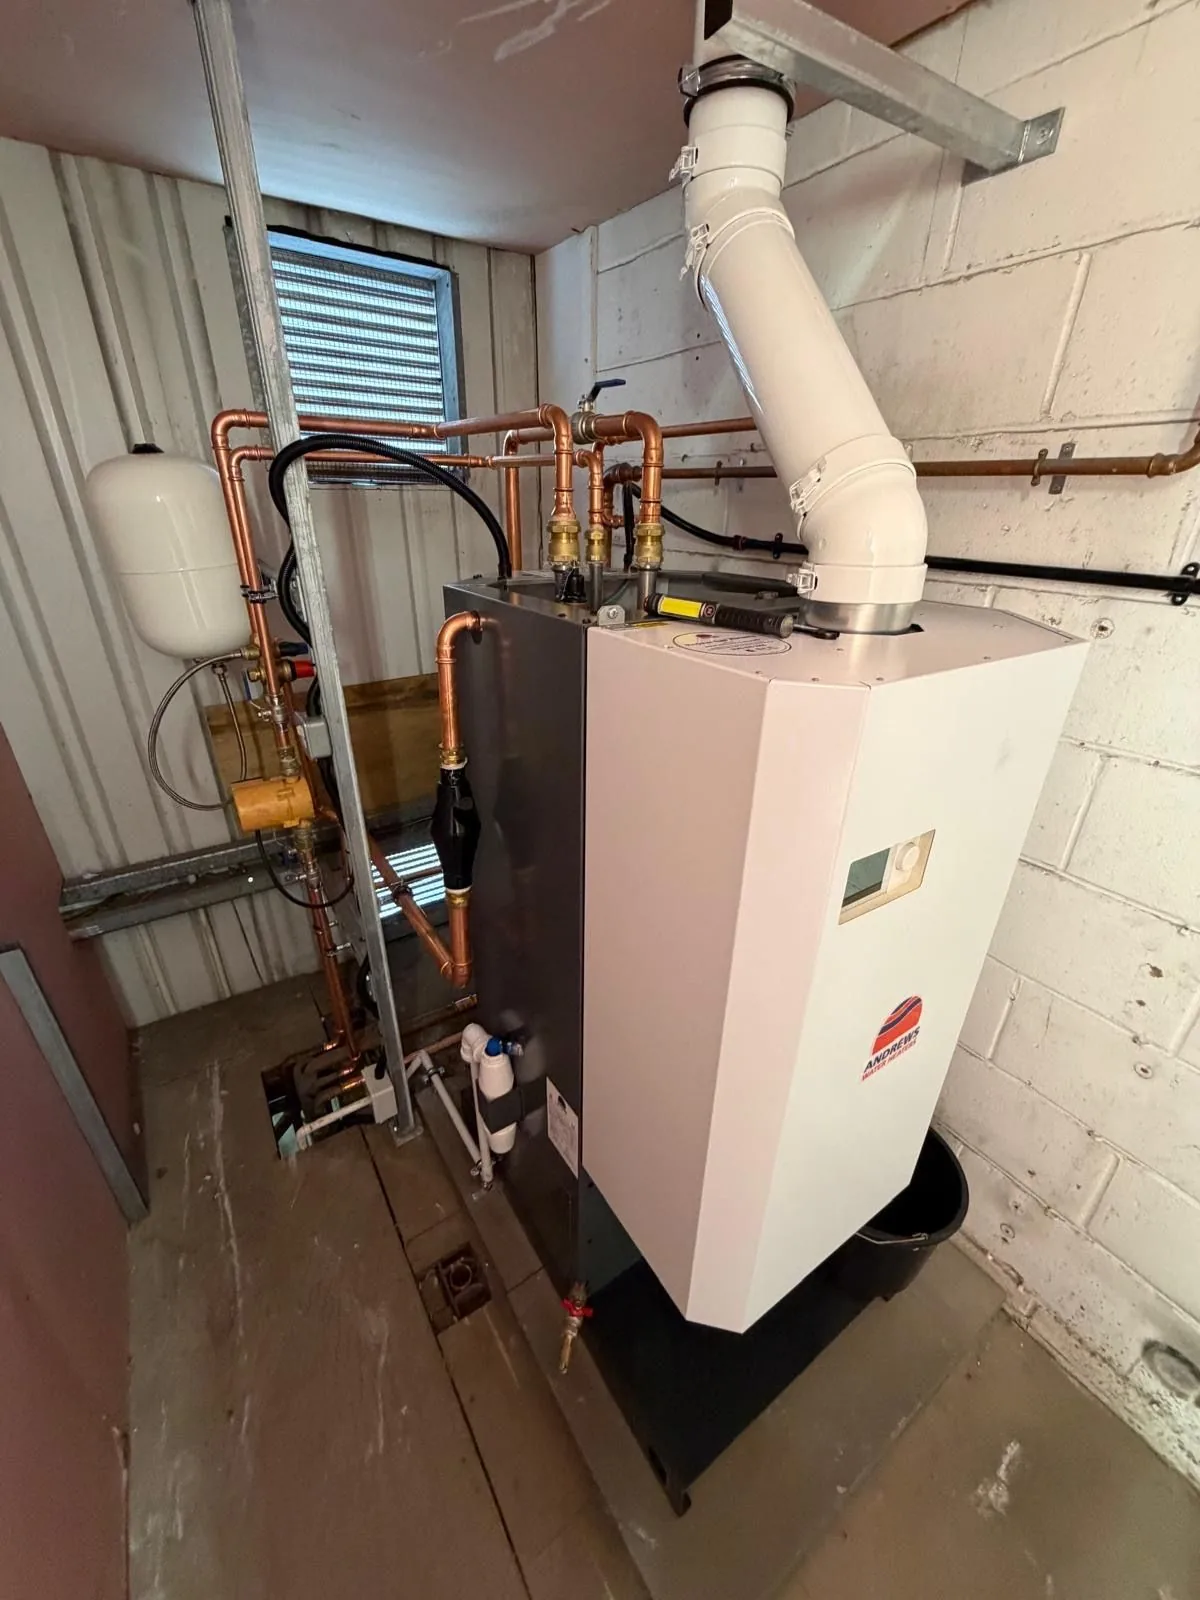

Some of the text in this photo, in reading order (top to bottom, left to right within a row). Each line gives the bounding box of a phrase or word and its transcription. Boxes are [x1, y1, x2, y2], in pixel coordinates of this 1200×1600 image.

[862, 1039, 917, 1081] WATER HEATERS
[863, 1026, 920, 1073] ANDREWS
